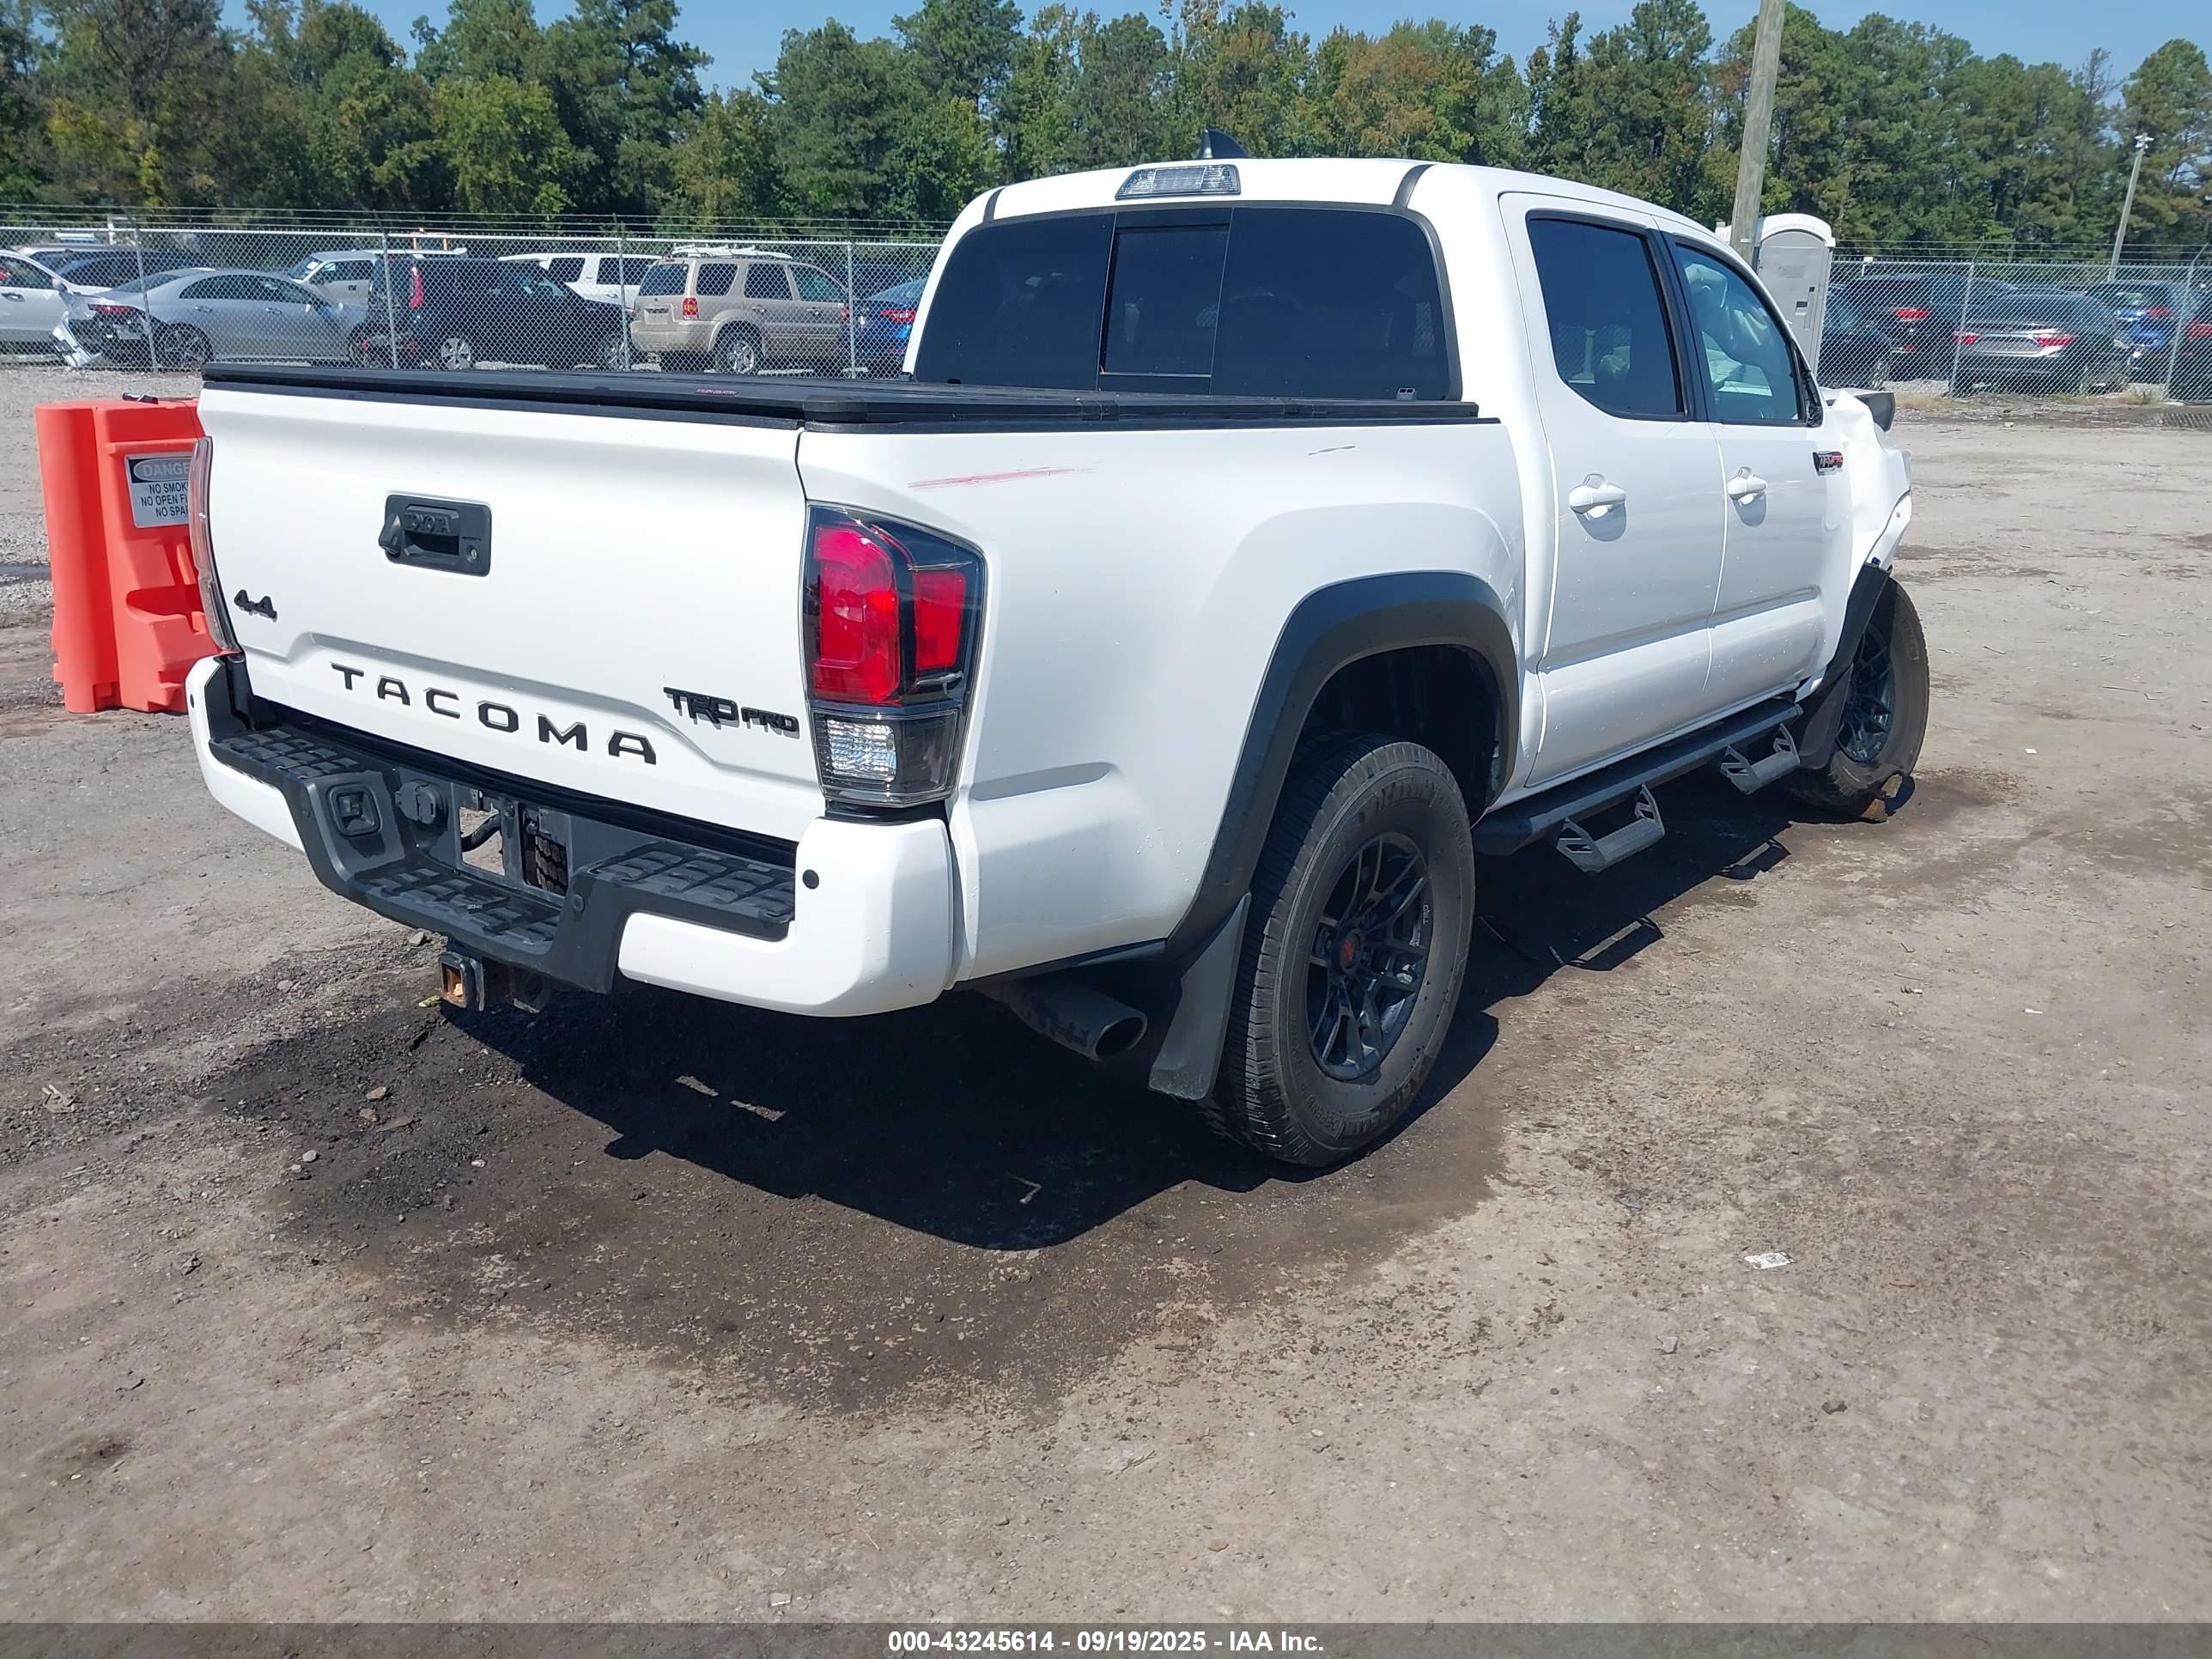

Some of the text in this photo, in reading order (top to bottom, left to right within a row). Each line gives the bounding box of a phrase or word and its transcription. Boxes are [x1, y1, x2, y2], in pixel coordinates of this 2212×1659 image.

[149, 483, 161, 495] NO
[141, 495, 154, 507] NO
[155, 493, 179, 506] OPEN
[155, 507, 168, 518] NO
[331, 661, 657, 765] TACOMA
[663, 686, 799, 732] TRD PRO
